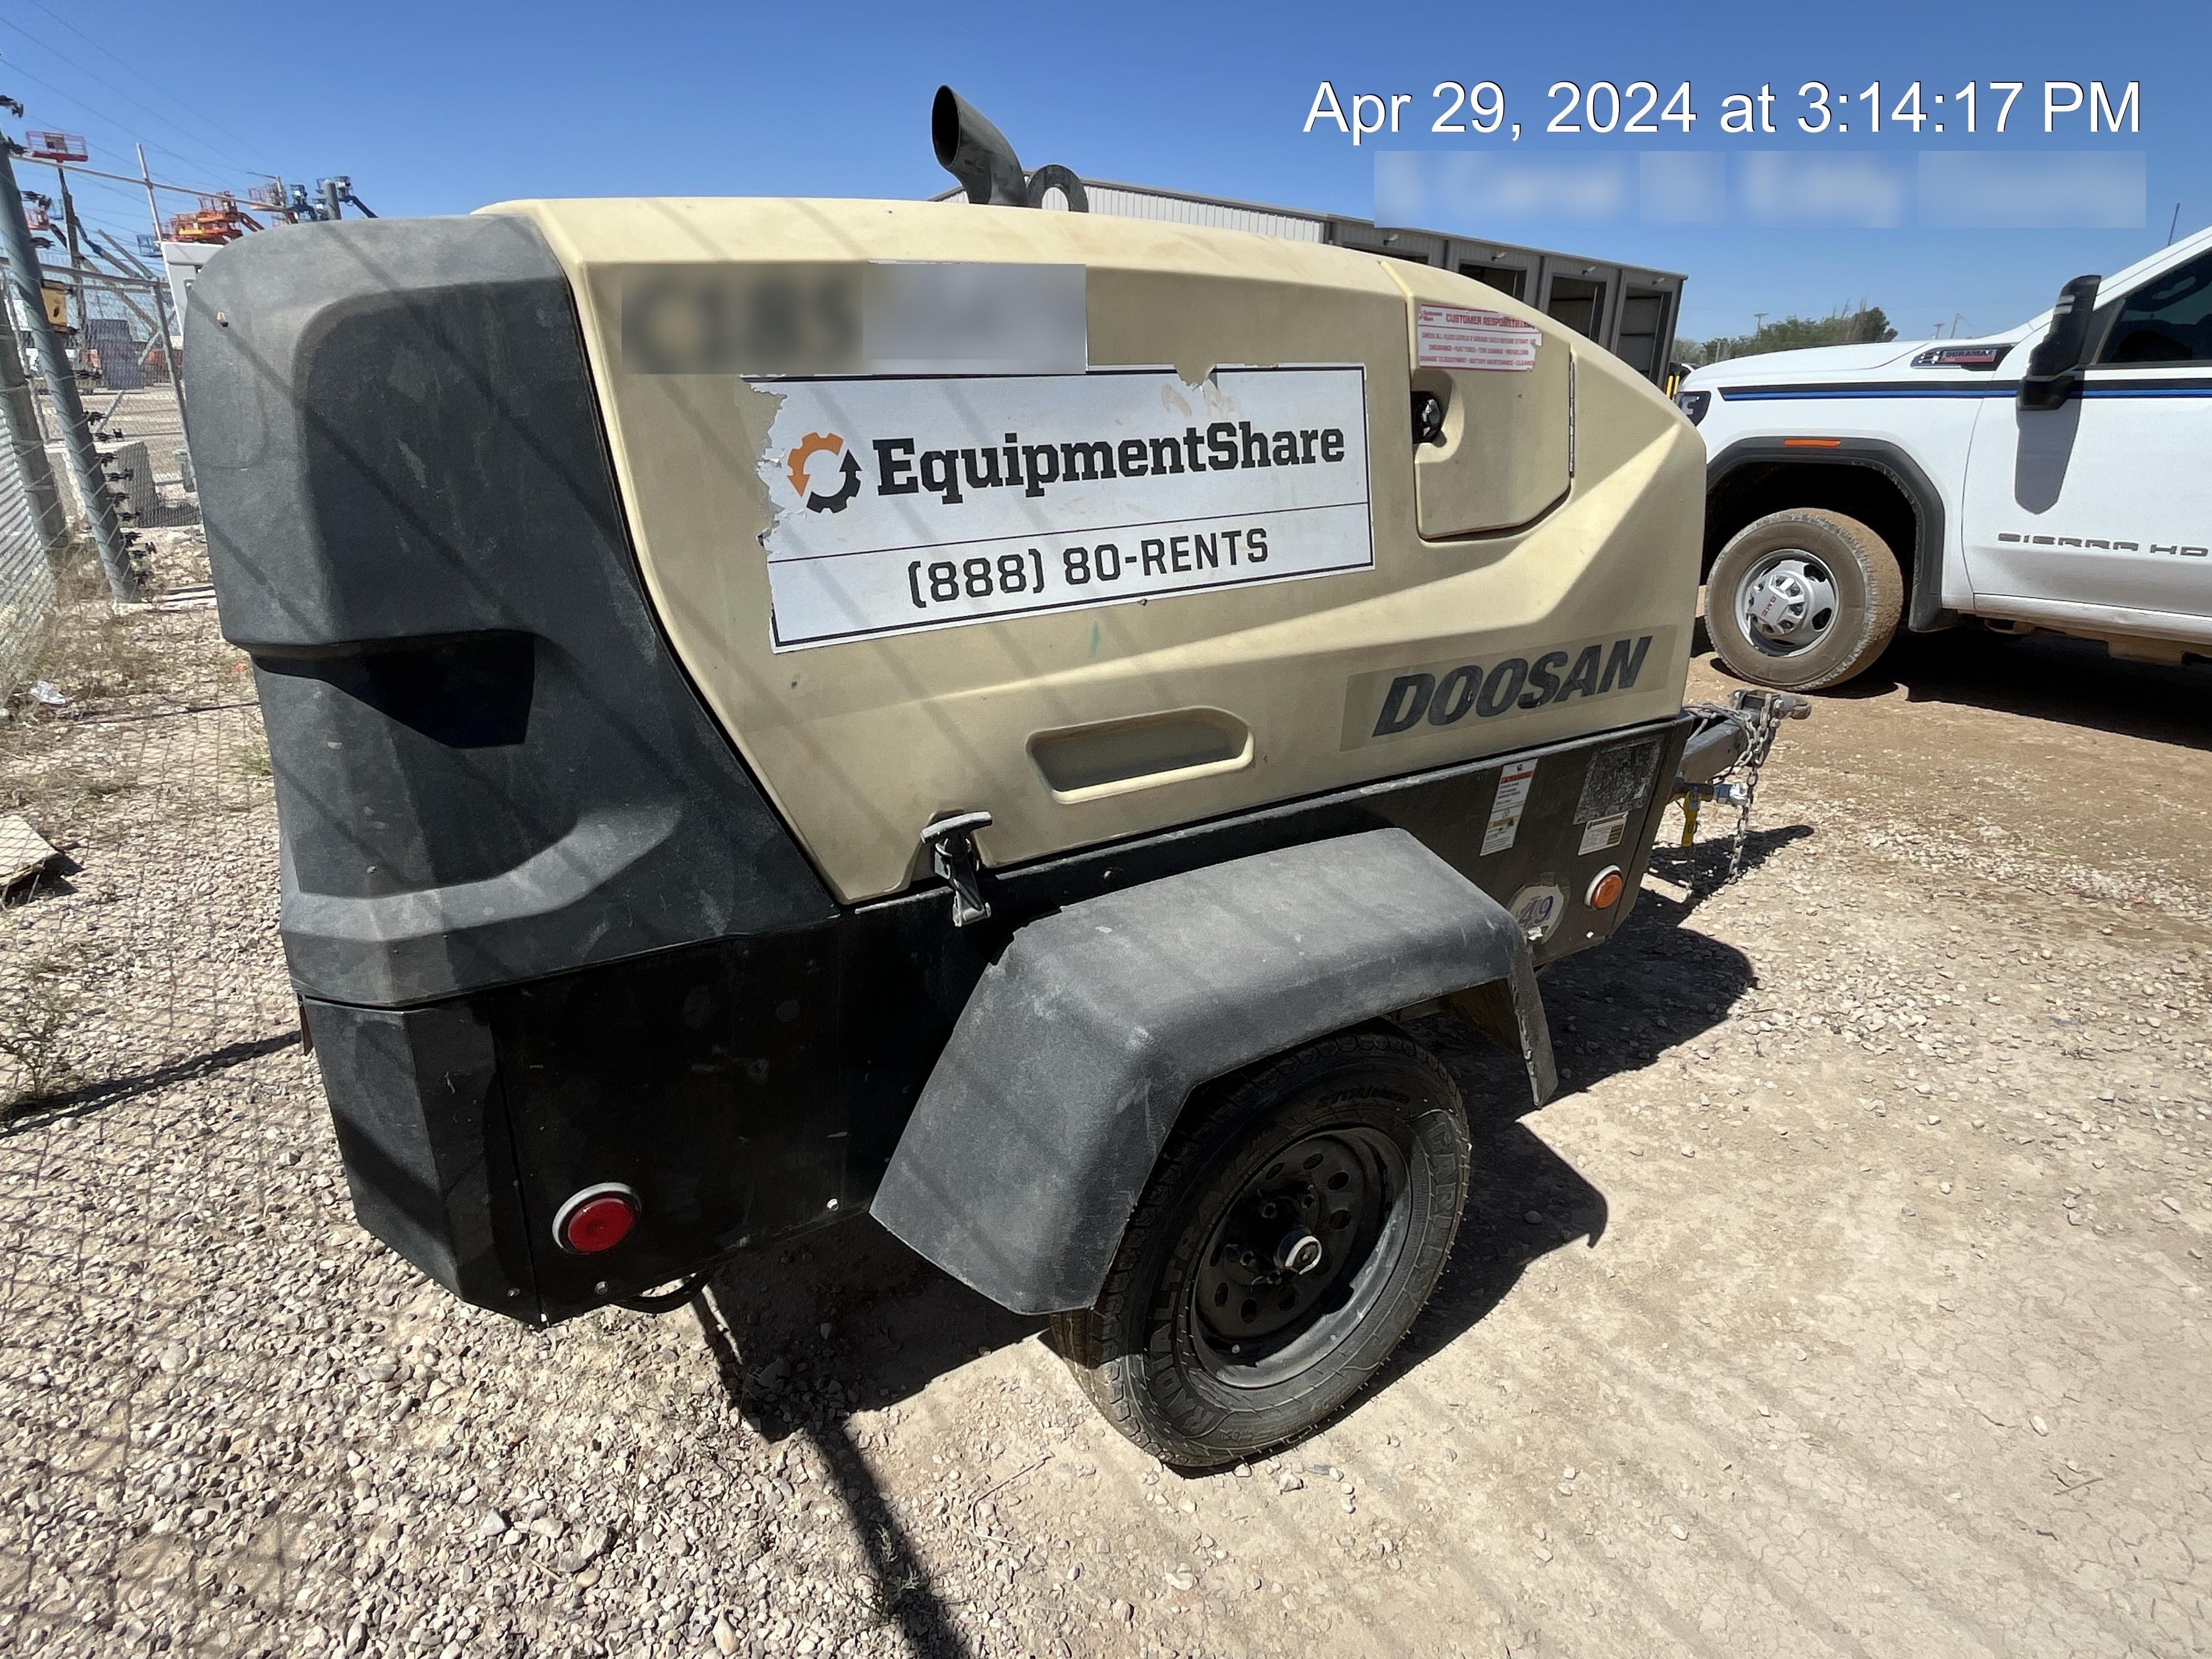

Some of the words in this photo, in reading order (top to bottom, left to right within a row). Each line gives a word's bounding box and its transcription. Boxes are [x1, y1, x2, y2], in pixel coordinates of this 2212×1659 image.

[872, 421, 1345, 505] EquipmentShare
[908, 548, 1045, 609] (888)
[1063, 528, 1268, 585] 80-RENTS
[1997, 533, 2139, 551] SIERRA
[2149, 544, 2209, 557] HD
[1372, 635, 1654, 738] DOOSAN
